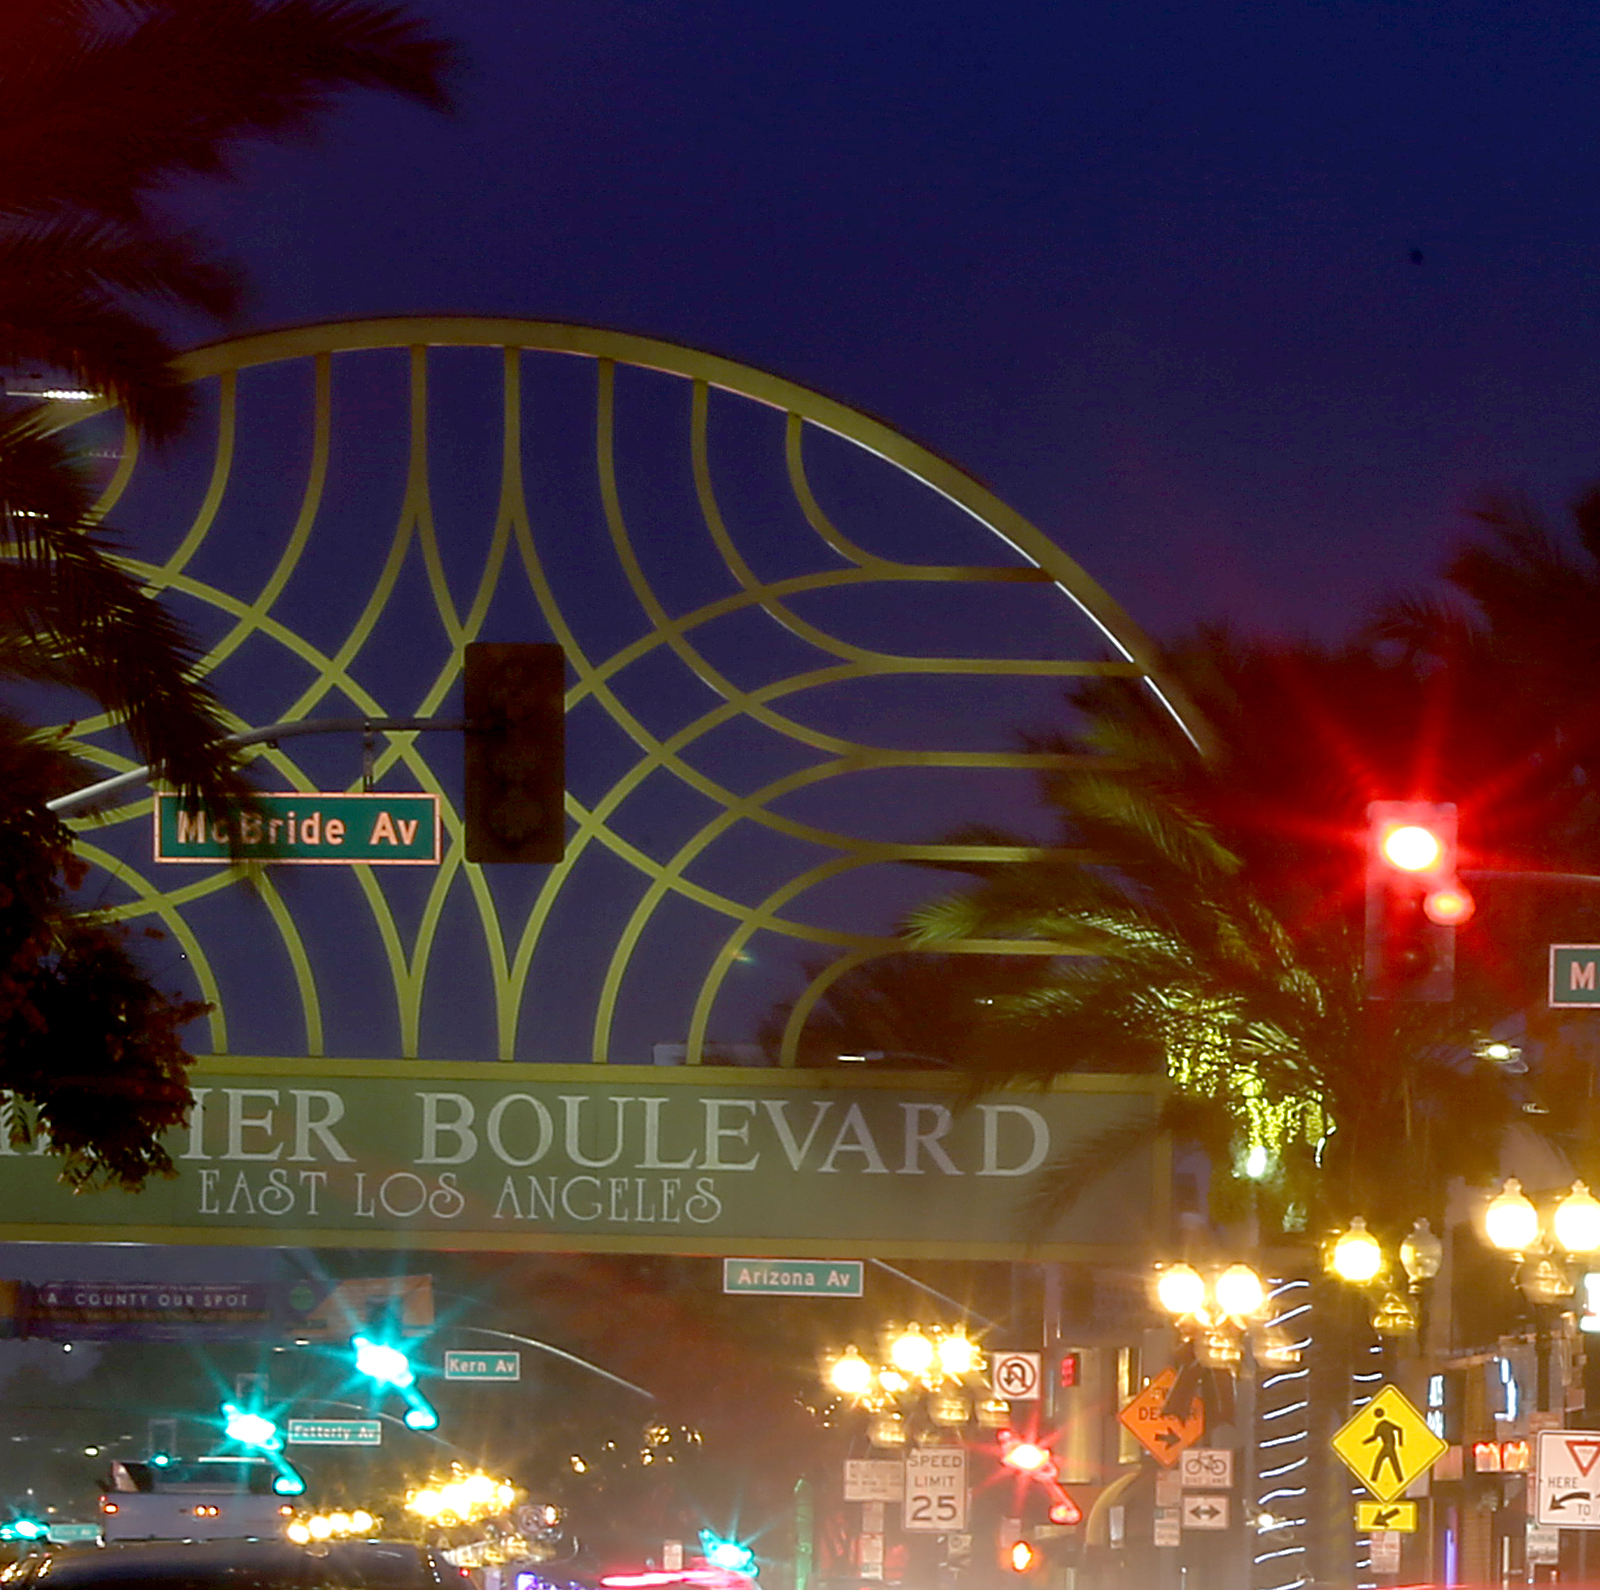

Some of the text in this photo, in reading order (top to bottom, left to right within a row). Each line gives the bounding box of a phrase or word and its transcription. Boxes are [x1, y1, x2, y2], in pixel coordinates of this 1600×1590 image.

[177, 810, 419, 845] McBride Av
[415, 1091, 1051, 1178] BOULEVARD
[198, 1168, 723, 1225] EAST LOS ANGELES
[737, 1268, 851, 1287] Arizona Av
[74, 1293, 149, 1306] COUNTY
[158, 1294, 194, 1307] OUR
[204, 1294, 249, 1308] SPOT
[449, 1358, 515, 1373] Kern Av
[294, 1424, 377, 1440] Fetterly Av
[909, 1455, 963, 1468] SPEED
[914, 1475, 956, 1488] LIMIT
[1548, 1476, 1578, 1489] HERE
[911, 1495, 957, 1522] 25
[1577, 1503, 1591, 1516] TO
